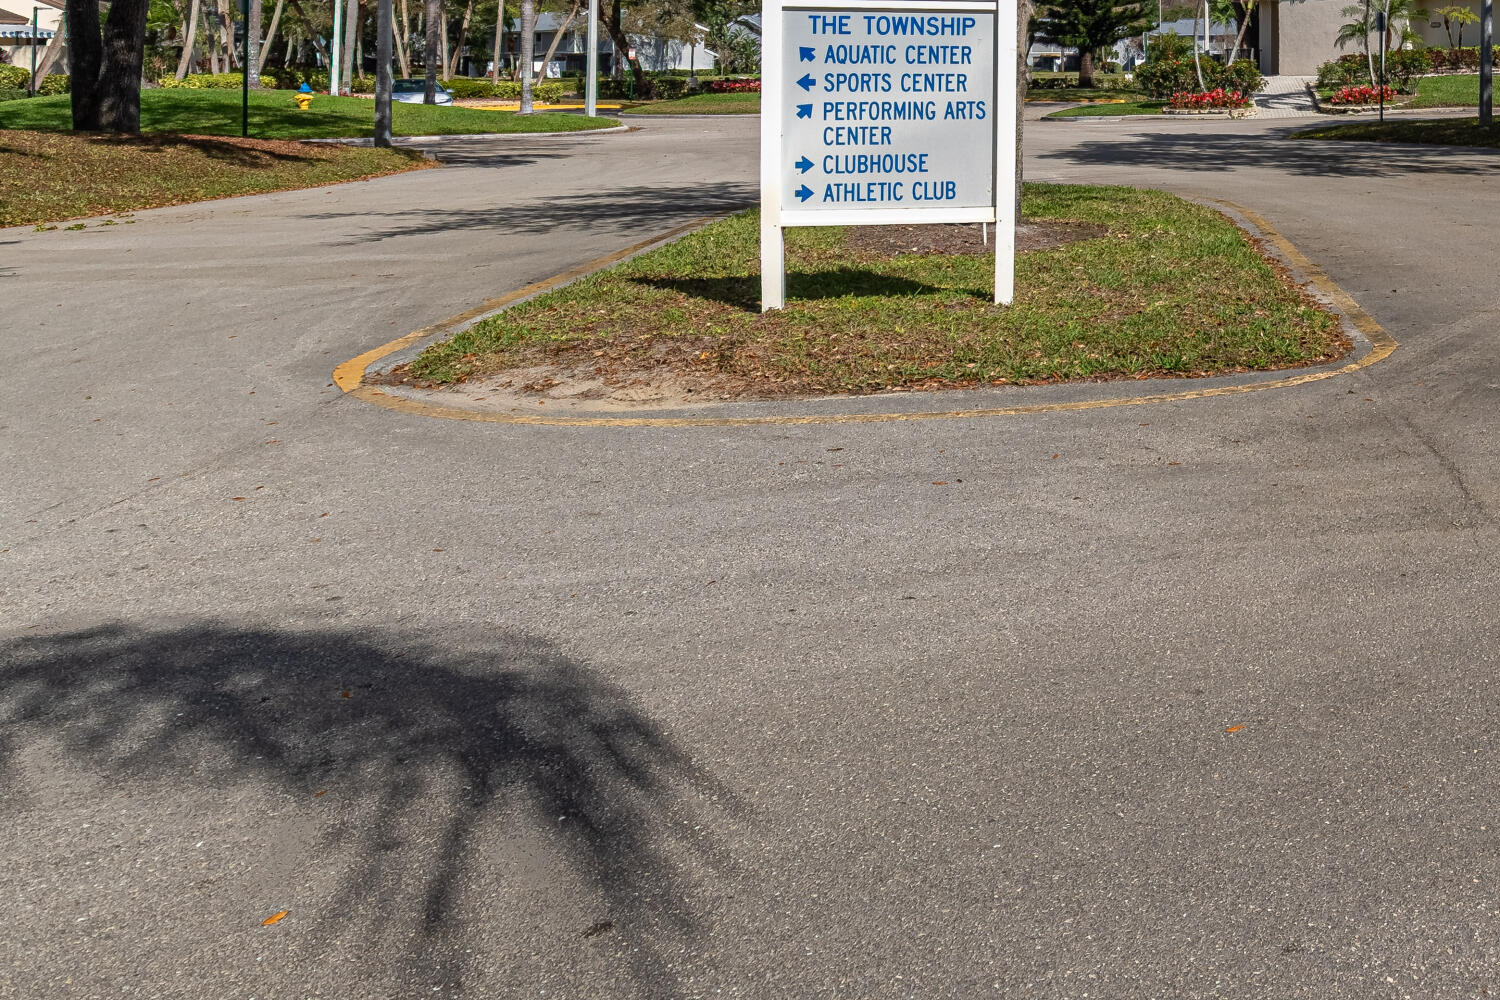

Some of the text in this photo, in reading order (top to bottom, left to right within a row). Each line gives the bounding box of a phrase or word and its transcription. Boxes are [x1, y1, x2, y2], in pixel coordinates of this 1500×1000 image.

[808, 14, 977, 37] THE TOWNSHIP
[823, 44, 972, 65] AQUATIC CENTER
[823, 72, 968, 93] SPORTS CENTER
[823, 100, 987, 121] PERFORMING ARTS
[823, 126, 892, 146] CENTER
[823, 153, 929, 175] CLUBHOUSE
[823, 181, 957, 203] ATHLETIC CLUB
